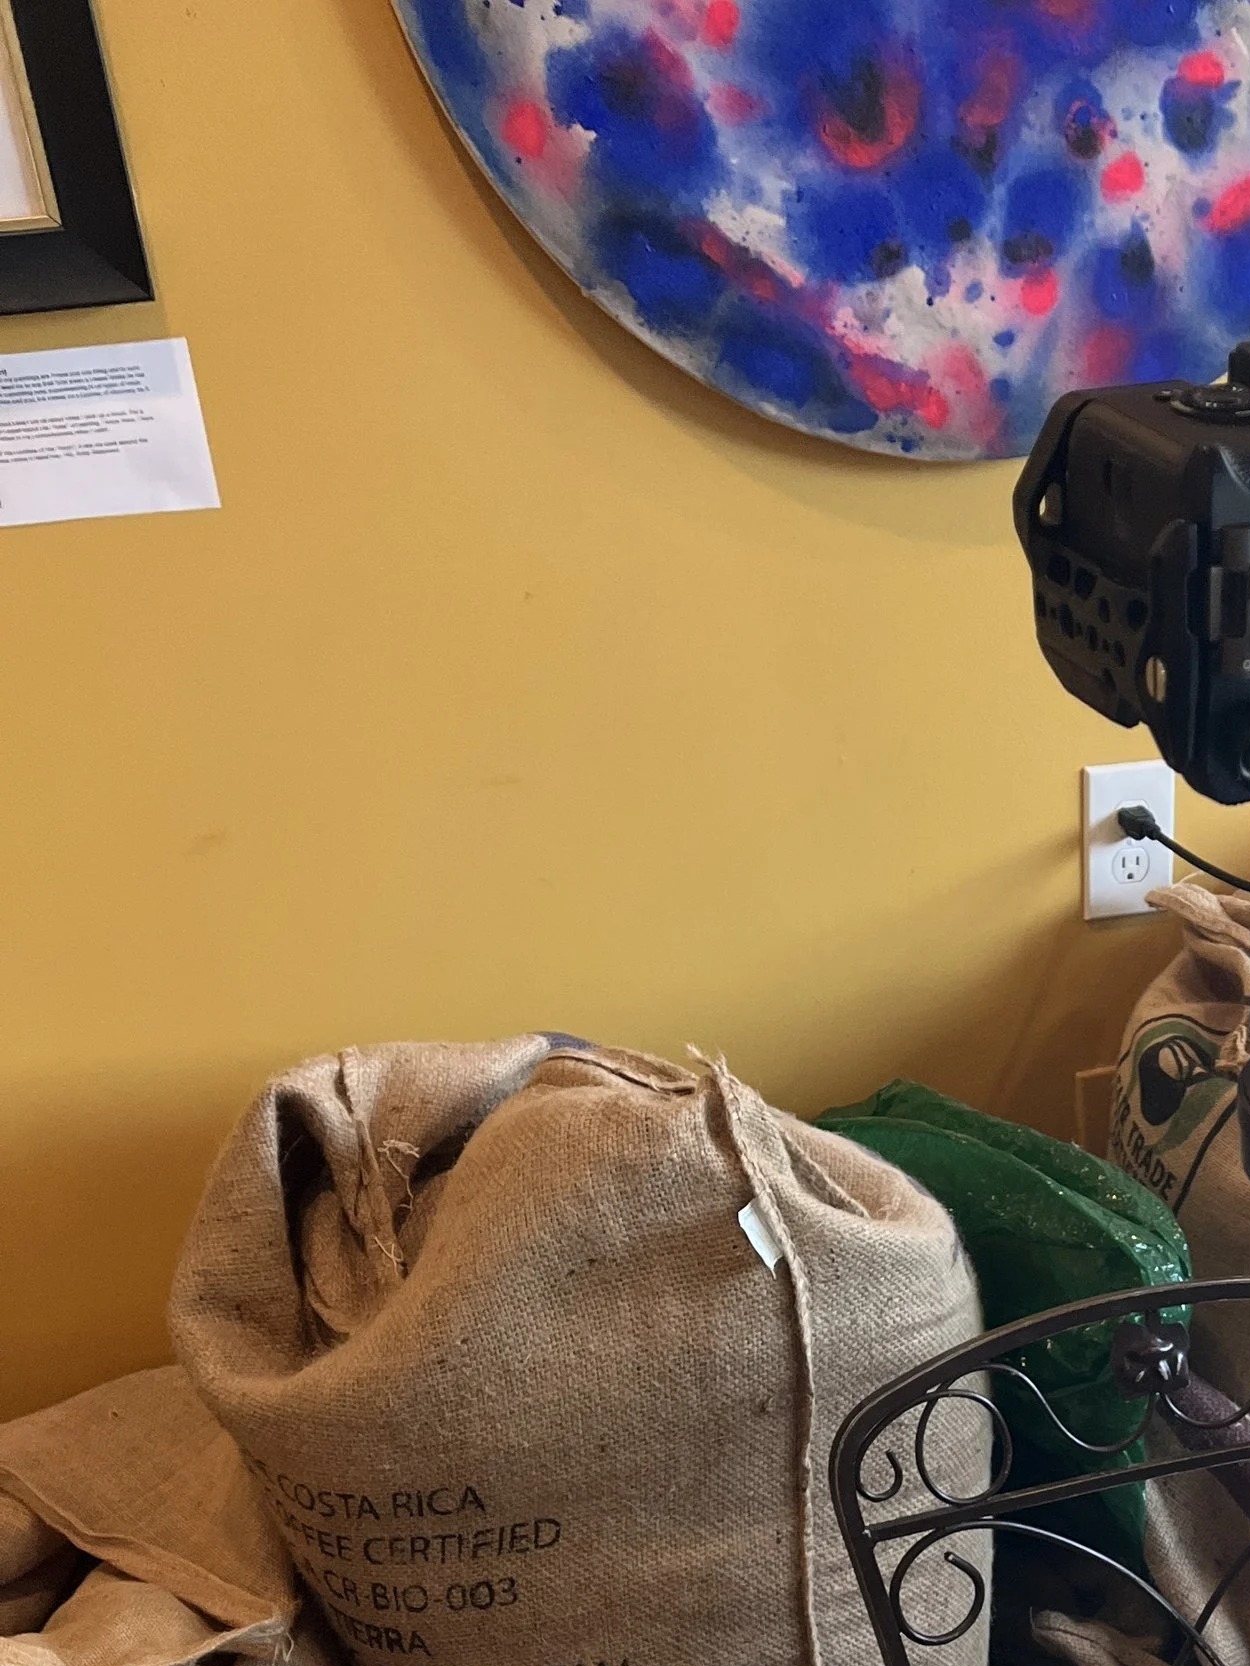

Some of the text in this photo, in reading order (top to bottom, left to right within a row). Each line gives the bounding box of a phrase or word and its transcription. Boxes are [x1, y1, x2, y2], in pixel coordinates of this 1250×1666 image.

[278, 1474, 486, 1520] COSTA RICA
[363, 1517, 562, 1566] CERTIFIED
